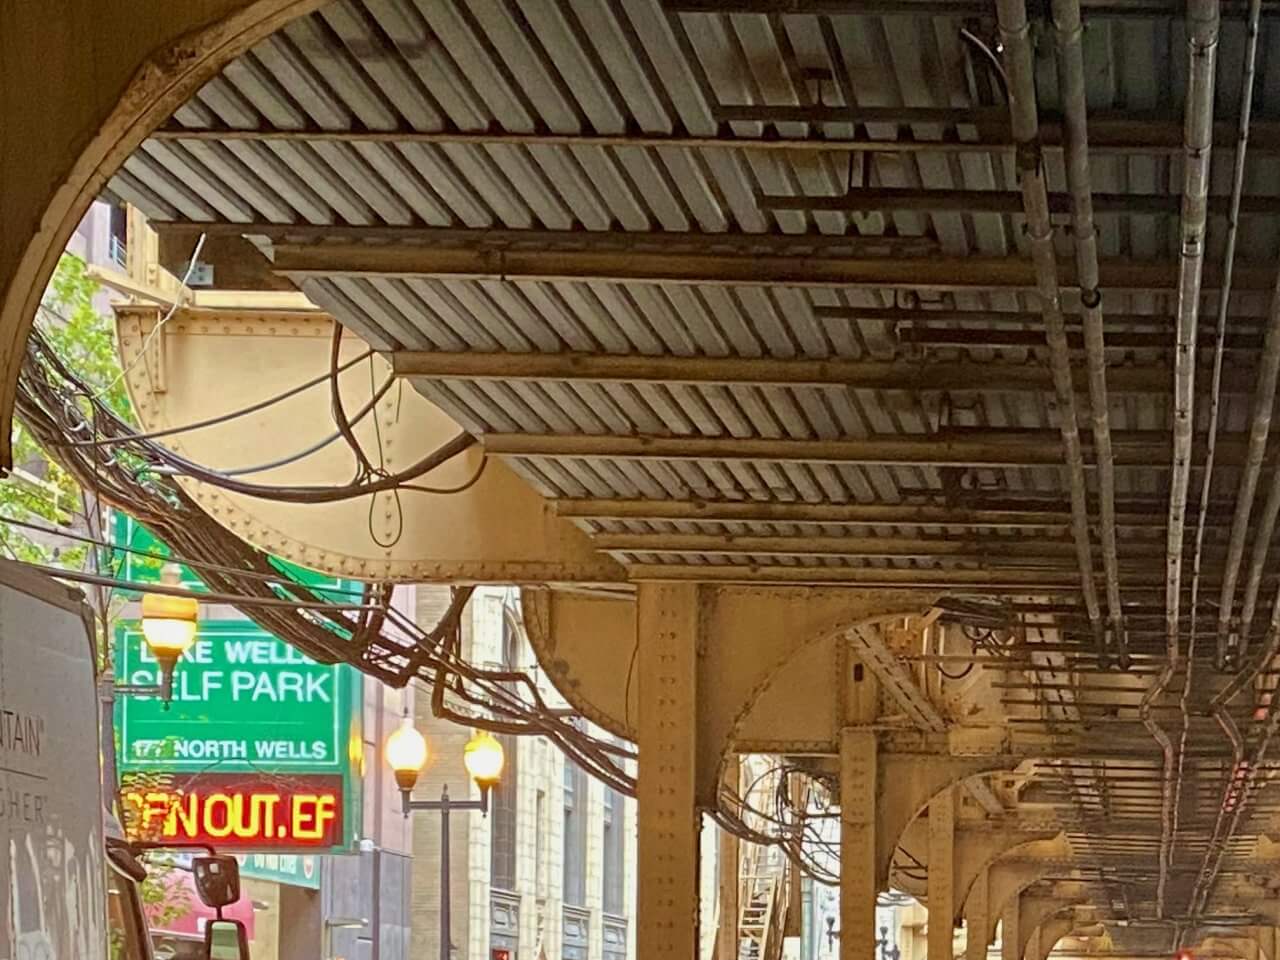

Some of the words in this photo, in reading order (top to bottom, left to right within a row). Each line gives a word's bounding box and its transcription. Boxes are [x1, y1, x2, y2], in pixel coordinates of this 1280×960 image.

[140, 640, 212, 663] LKE
[231, 672, 330, 701] PARK
[175, 740, 247, 758] NORTH
[255, 740, 327, 759] WELLS
